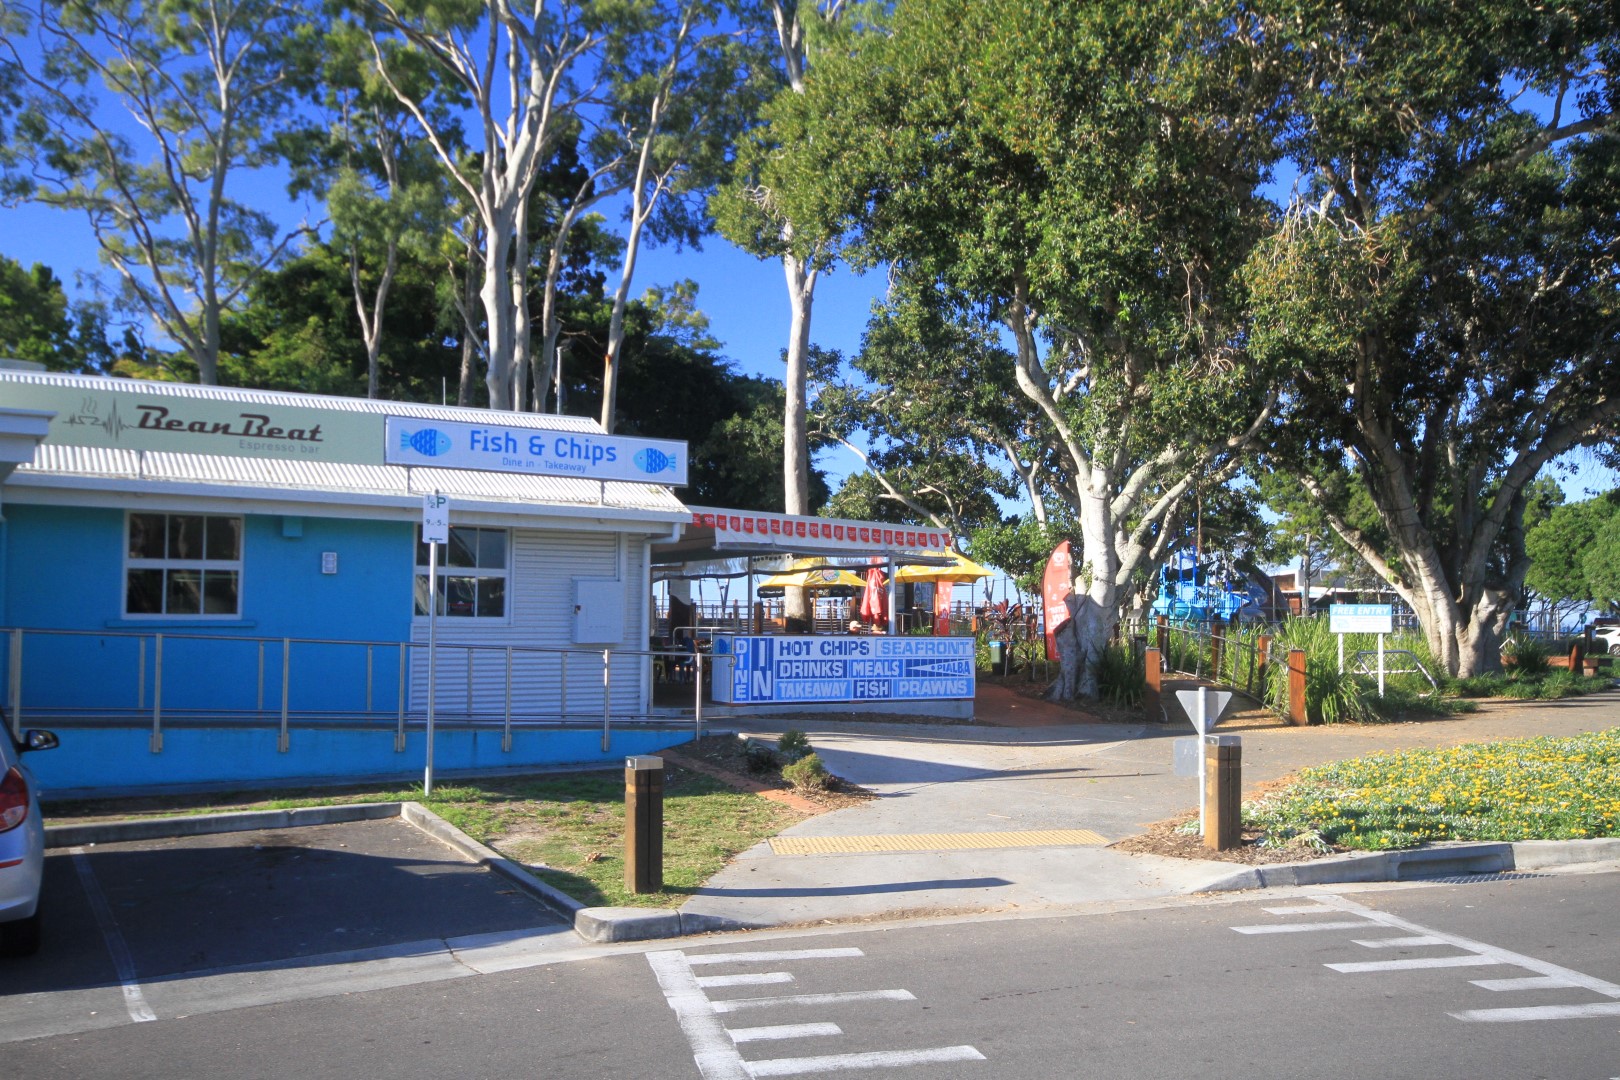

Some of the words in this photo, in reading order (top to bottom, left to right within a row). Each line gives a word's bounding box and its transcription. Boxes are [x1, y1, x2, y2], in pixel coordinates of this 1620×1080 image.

[239, 439, 296, 452] Espresso
[300, 443, 321, 454] bar
[470, 429, 518, 454] Fish
[528, 435, 546, 456] &
[554, 437, 617, 466] Chips
[502, 457, 523, 468] Dine
[526, 457, 535, 468] in
[544, 461, 587, 473] Takeaway
[1332, 606, 1355, 615] FREE
[1358, 606, 1389, 615] ENTRY
[780, 640, 814, 656] HOT
[820, 640, 870, 656] CHIPS
[881, 641, 969, 655] SEAFRONT
[735, 640, 748, 699] DINE
[753, 641, 772, 697] IN
[780, 661, 843, 677] DRINKS
[853, 661, 900, 676] MEALS
[937, 661, 971, 674] PIALBA
[780, 682, 847, 698] TAKEAWAY
[856, 681, 889, 697] FISH
[900, 681, 968, 696] PRAWNS
